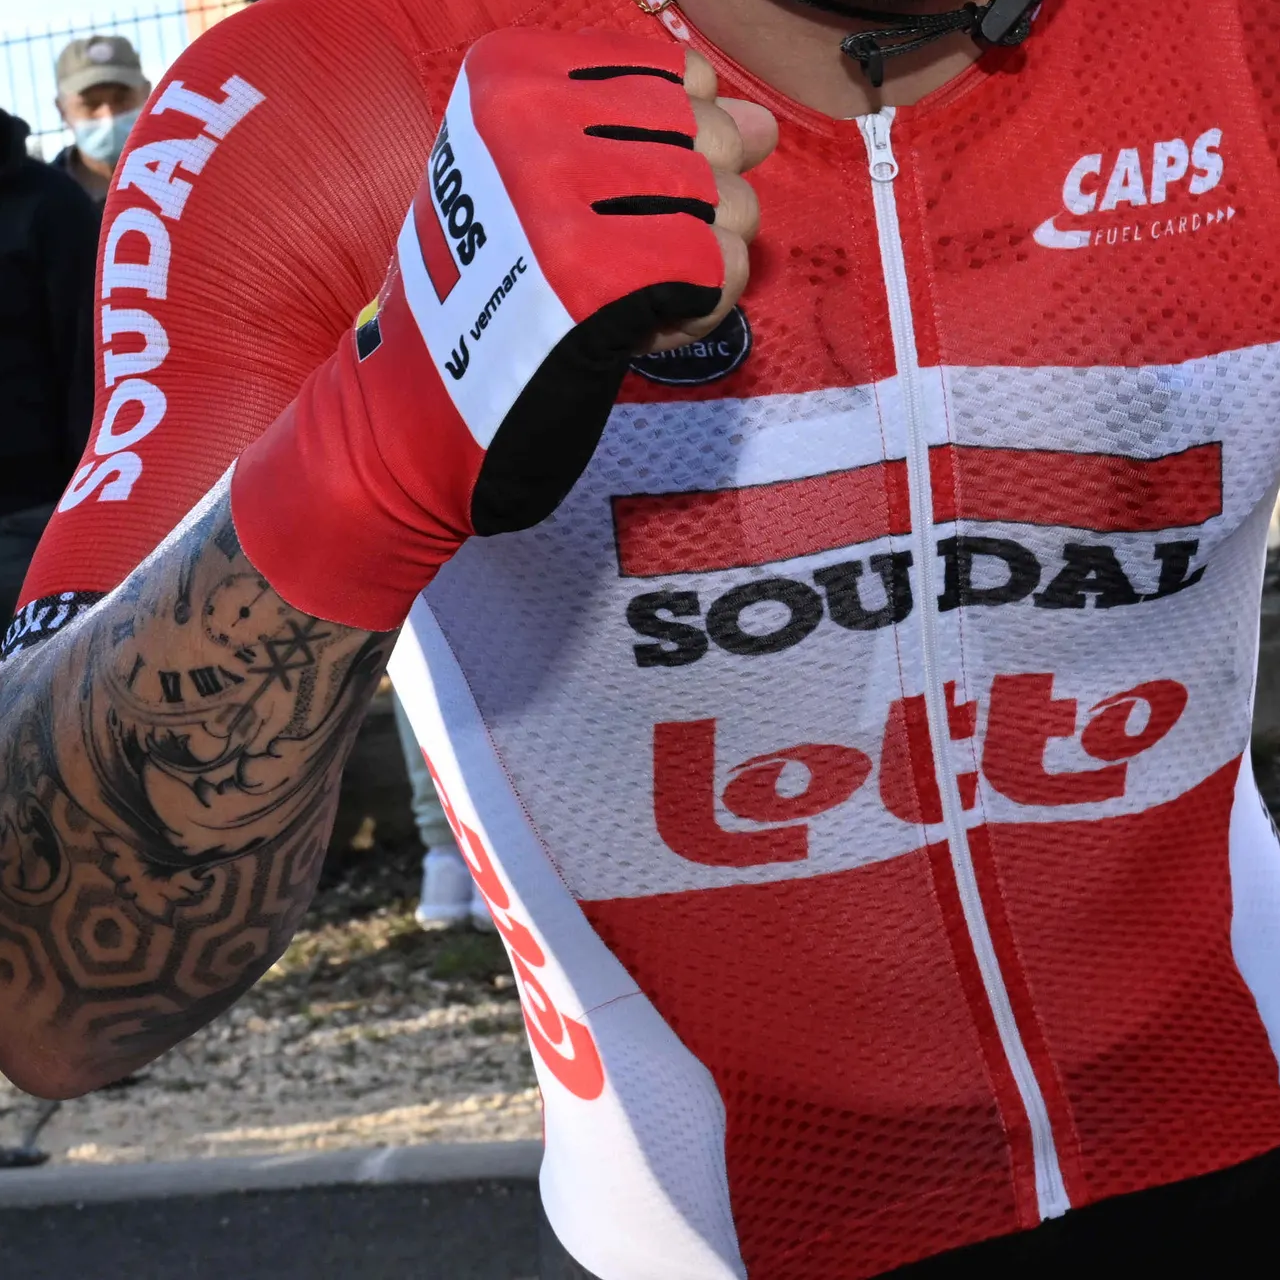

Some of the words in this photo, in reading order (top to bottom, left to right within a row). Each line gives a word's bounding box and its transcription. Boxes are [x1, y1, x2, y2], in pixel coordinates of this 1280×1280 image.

[1062, 127, 1224, 216] CAPS
[1094, 226, 1143, 246] FUEL
[1151, 213, 1201, 239] CARD
[57, 74, 266, 514] SOUDAL
[469, 255, 528, 341] vermarc
[623, 537, 1207, 669] SOUDAL
